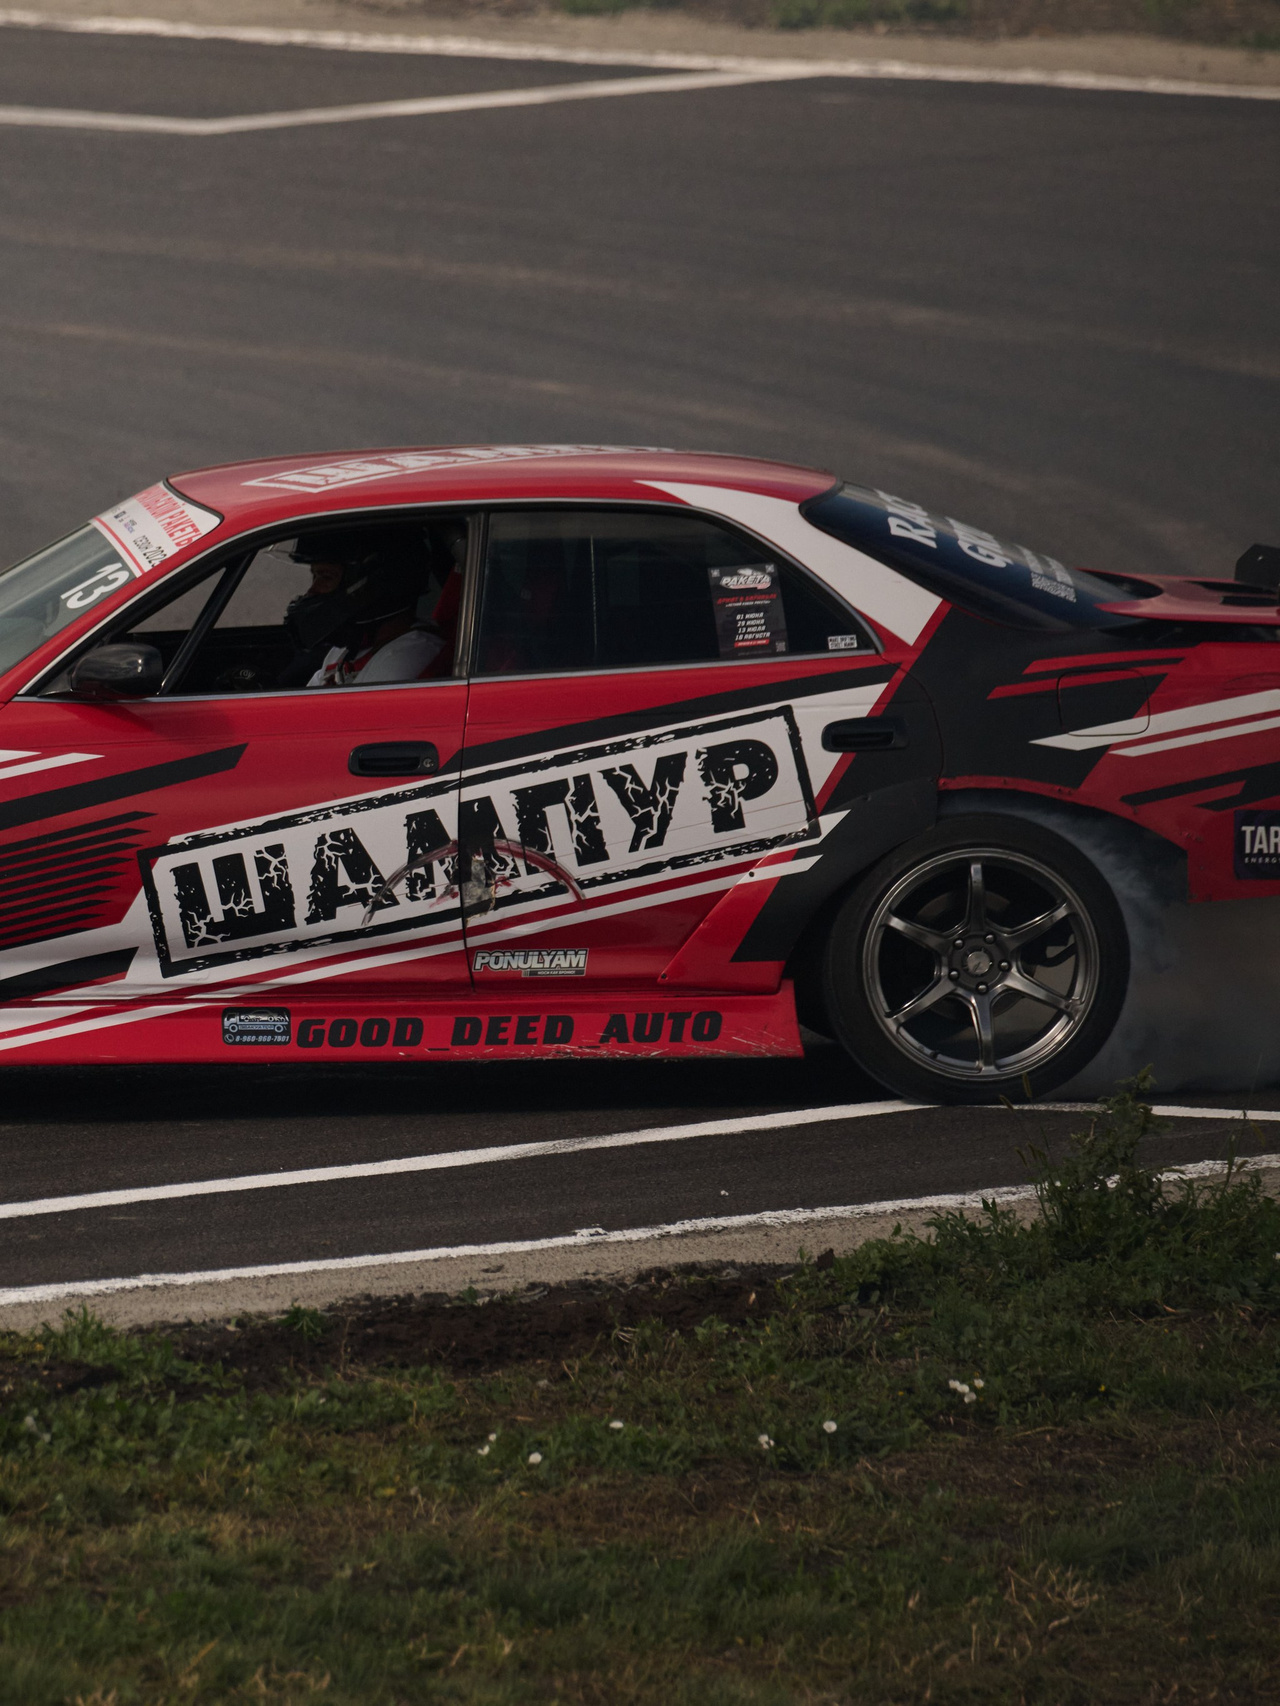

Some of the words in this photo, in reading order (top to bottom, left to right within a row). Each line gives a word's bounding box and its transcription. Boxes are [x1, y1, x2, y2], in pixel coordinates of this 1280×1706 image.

[60, 562, 130, 610] 13
[170, 738, 780, 950] ШАМПУР
[473, 950, 588, 971] PONULYAM
